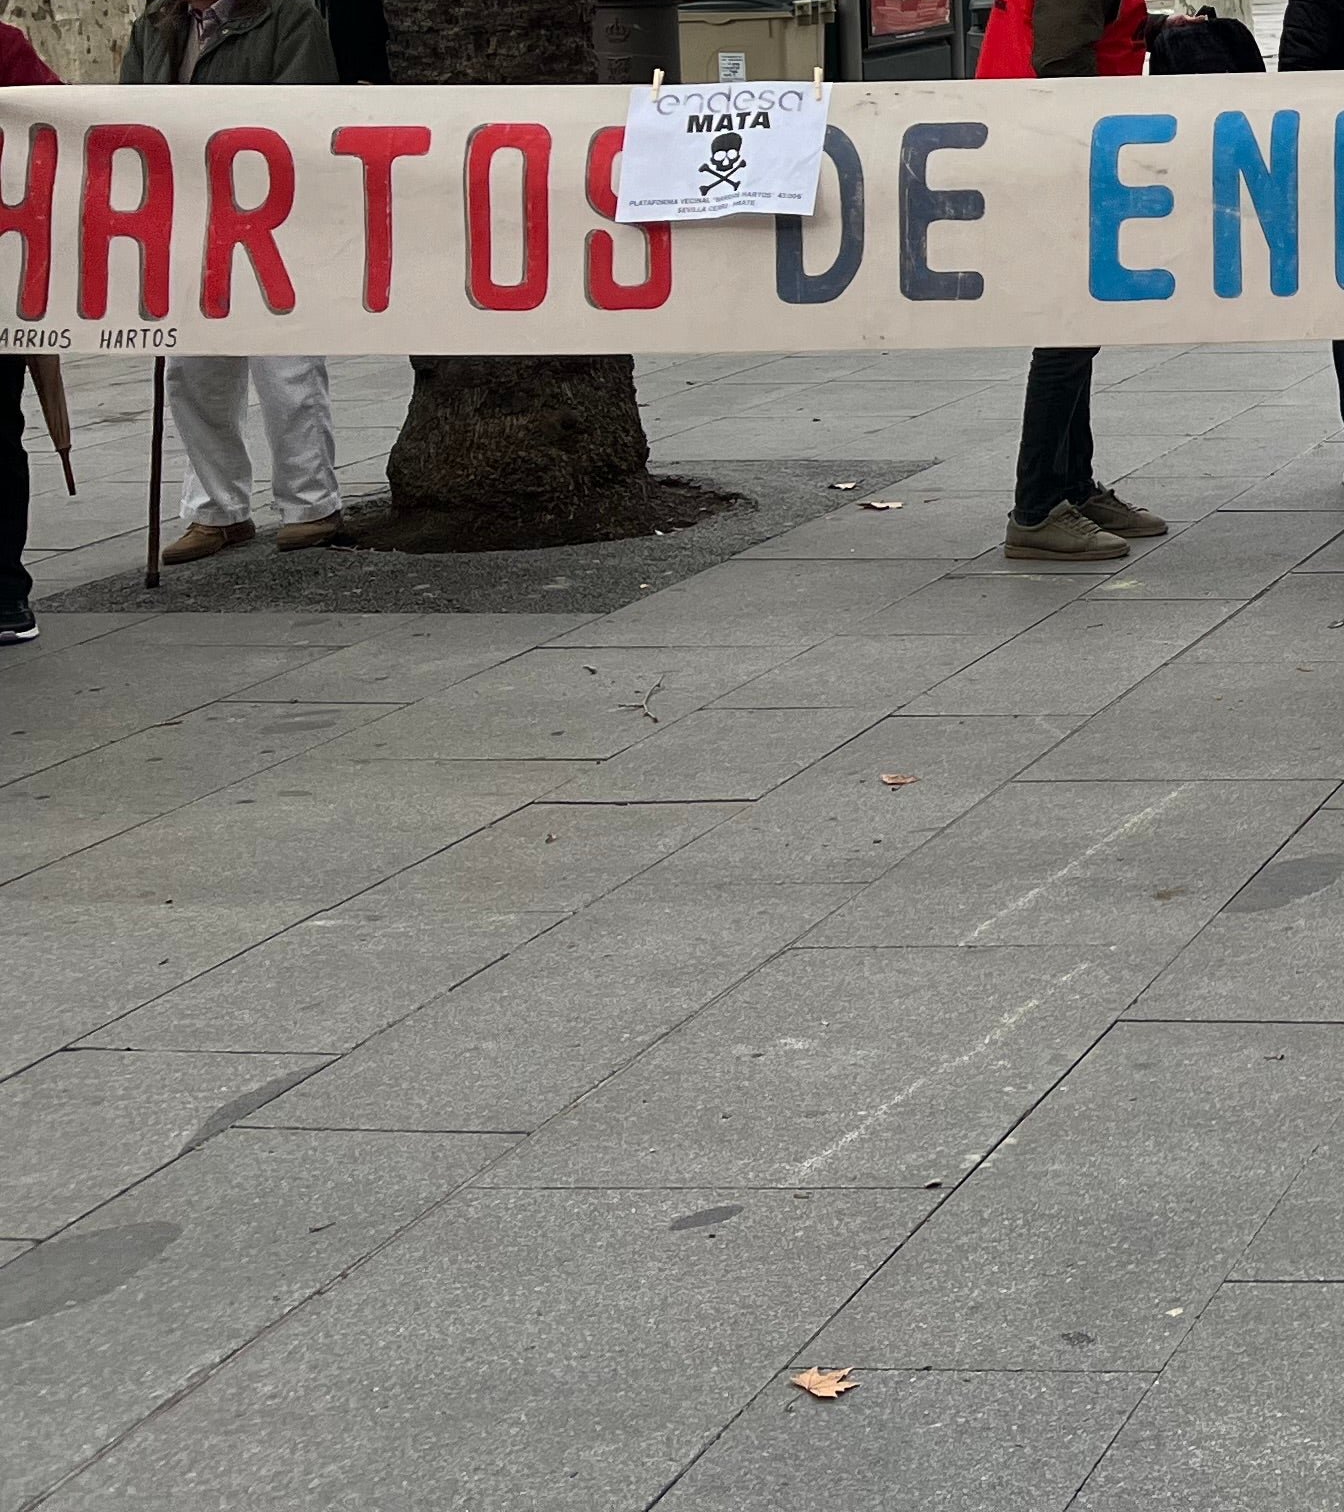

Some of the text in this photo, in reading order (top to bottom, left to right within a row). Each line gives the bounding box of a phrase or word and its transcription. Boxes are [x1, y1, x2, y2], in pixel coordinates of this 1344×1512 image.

[656, 85, 805, 116] endesa
[686, 111, 771, 134] MATA
[0, 122, 673, 321] HARTOS
[775, 122, 989, 304] DE
[99, 327, 178, 349] HARTOS
